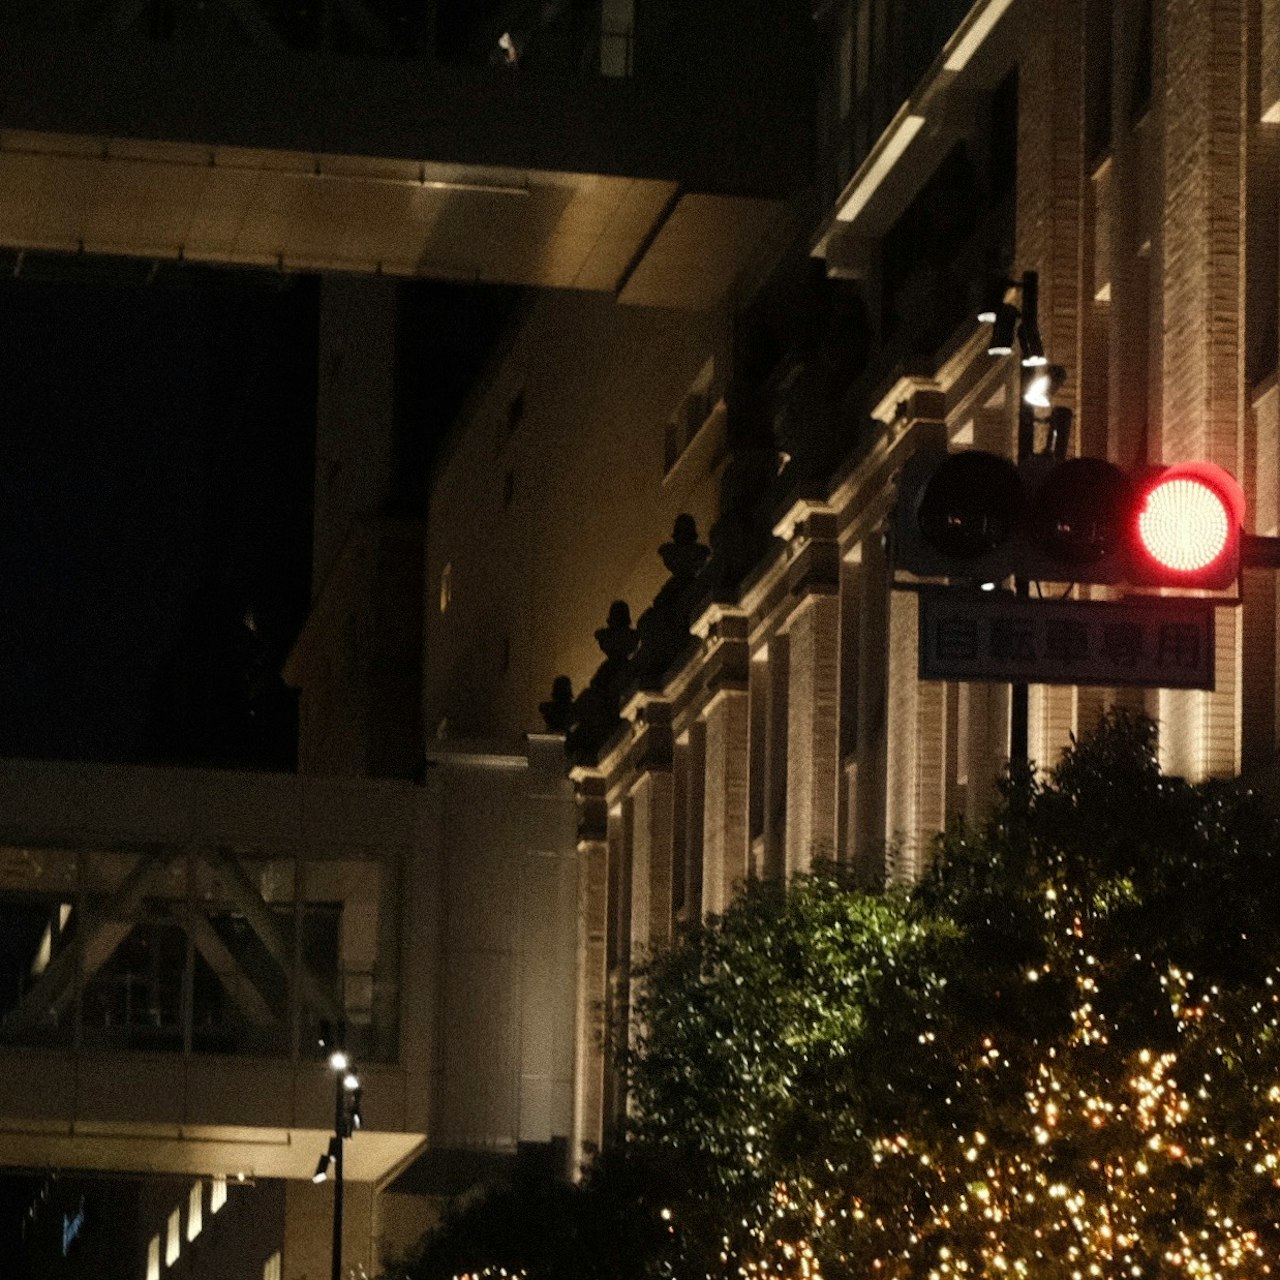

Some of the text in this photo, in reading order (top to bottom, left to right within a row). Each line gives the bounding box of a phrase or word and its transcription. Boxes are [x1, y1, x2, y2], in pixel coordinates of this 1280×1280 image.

[935, 615, 1201, 669] 自転車専用
